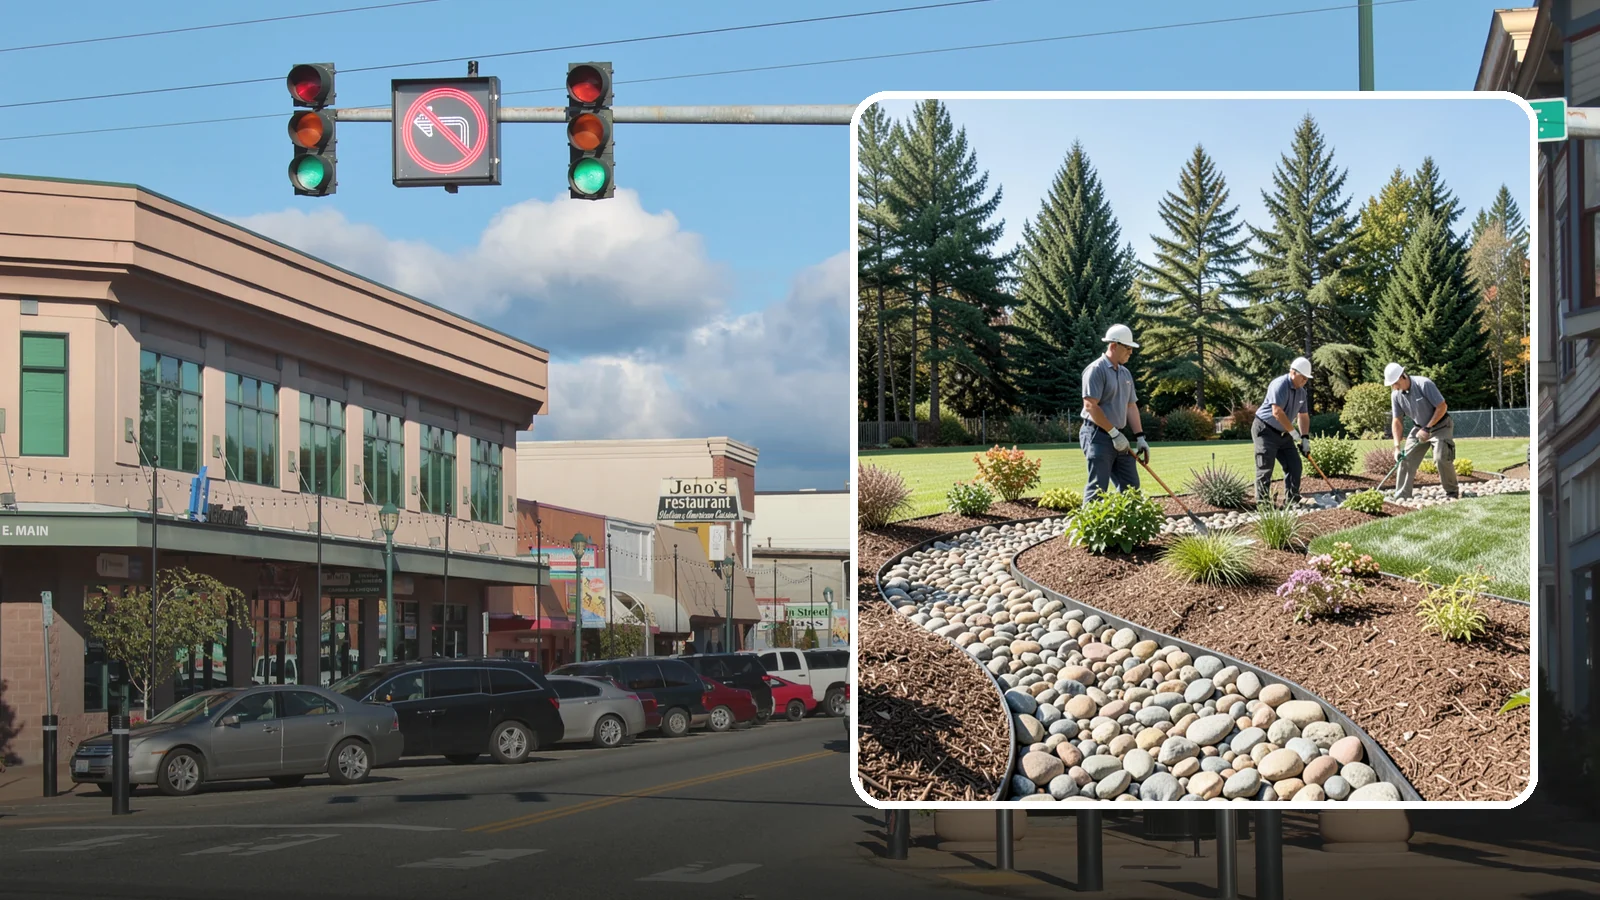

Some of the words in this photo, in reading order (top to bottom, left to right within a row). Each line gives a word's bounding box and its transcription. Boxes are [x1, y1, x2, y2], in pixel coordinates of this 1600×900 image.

[669, 479, 728, 494] Jeno's
[664, 496, 731, 509] restaurant
[658, 509, 682, 519] Italian
[685, 509, 714, 519] American
[714, 509, 738, 519] Cuisine
[2, 525, 13, 536] E.
[15, 525, 49, 536] MAIN
[797, 607, 828, 617] Street
[791, 619, 824, 627] lass
